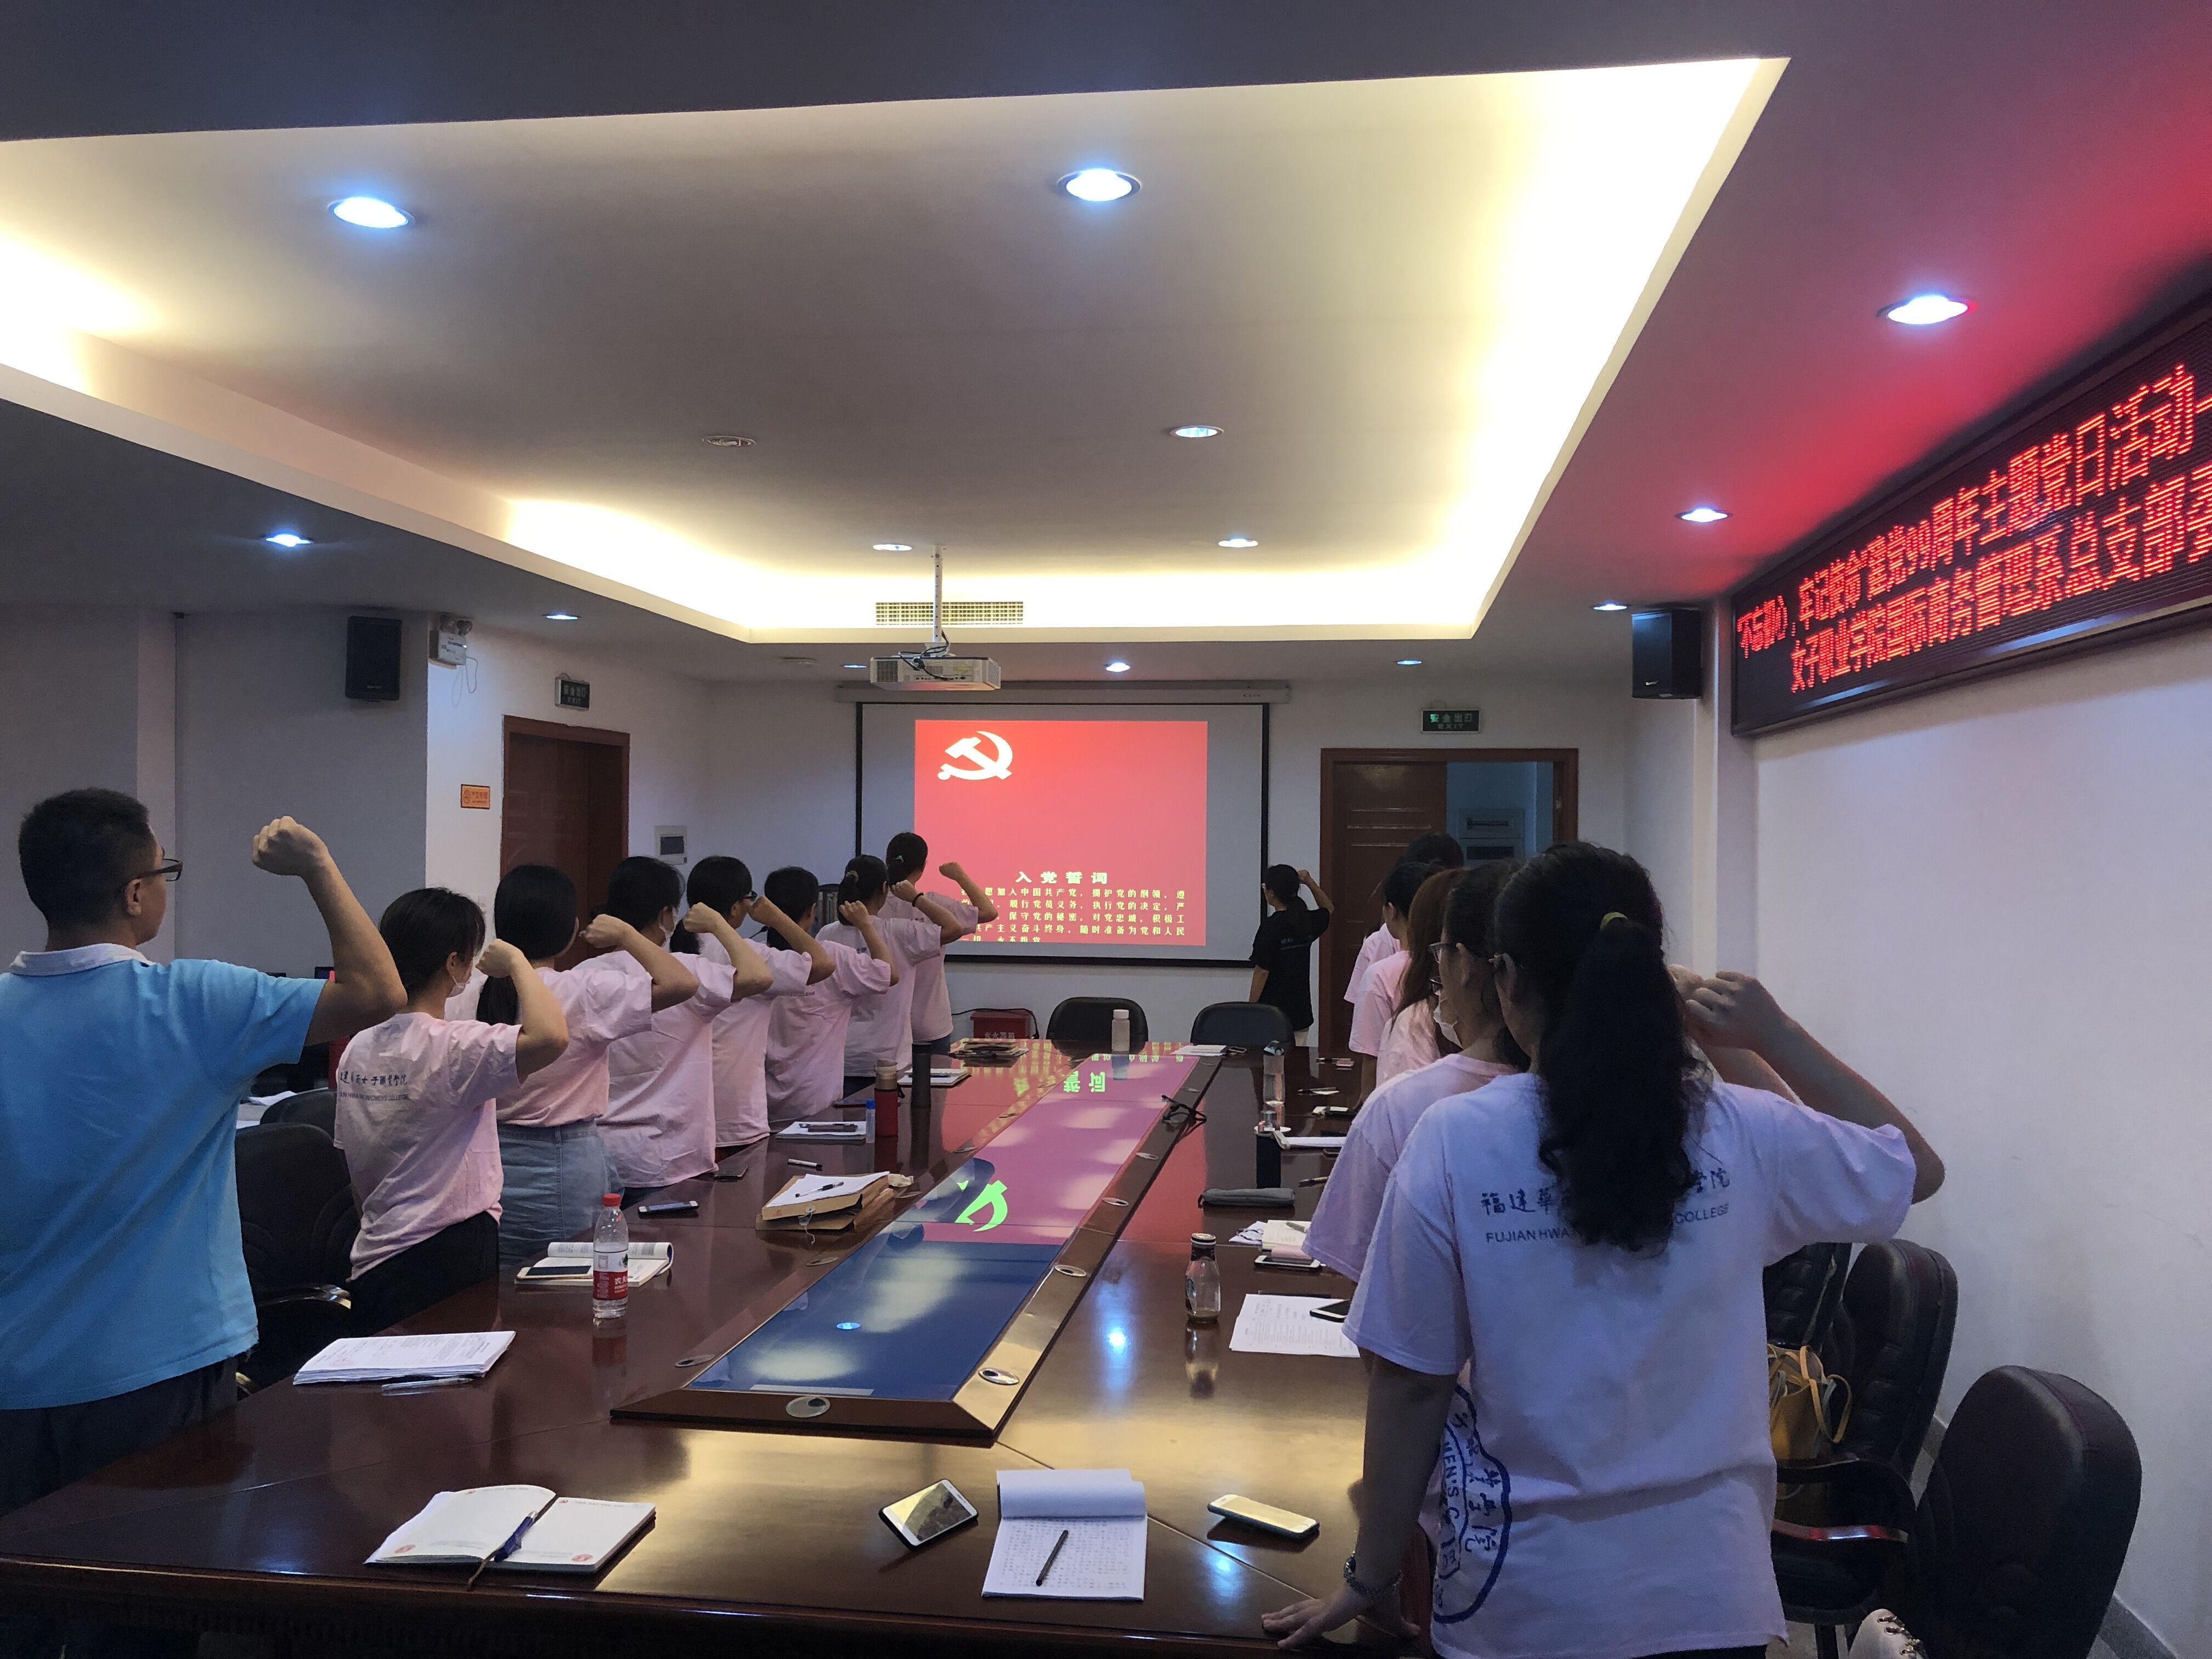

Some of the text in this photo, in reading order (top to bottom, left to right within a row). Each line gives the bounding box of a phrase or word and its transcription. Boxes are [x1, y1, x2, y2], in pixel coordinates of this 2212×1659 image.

[1430, 713, 1472, 723] 安全出口
[1015, 871, 1108, 884] 入党誓词
[1486, 1229, 1536, 1243] FUJIAN
[1674, 1203, 1729, 1224] COLLEGE
